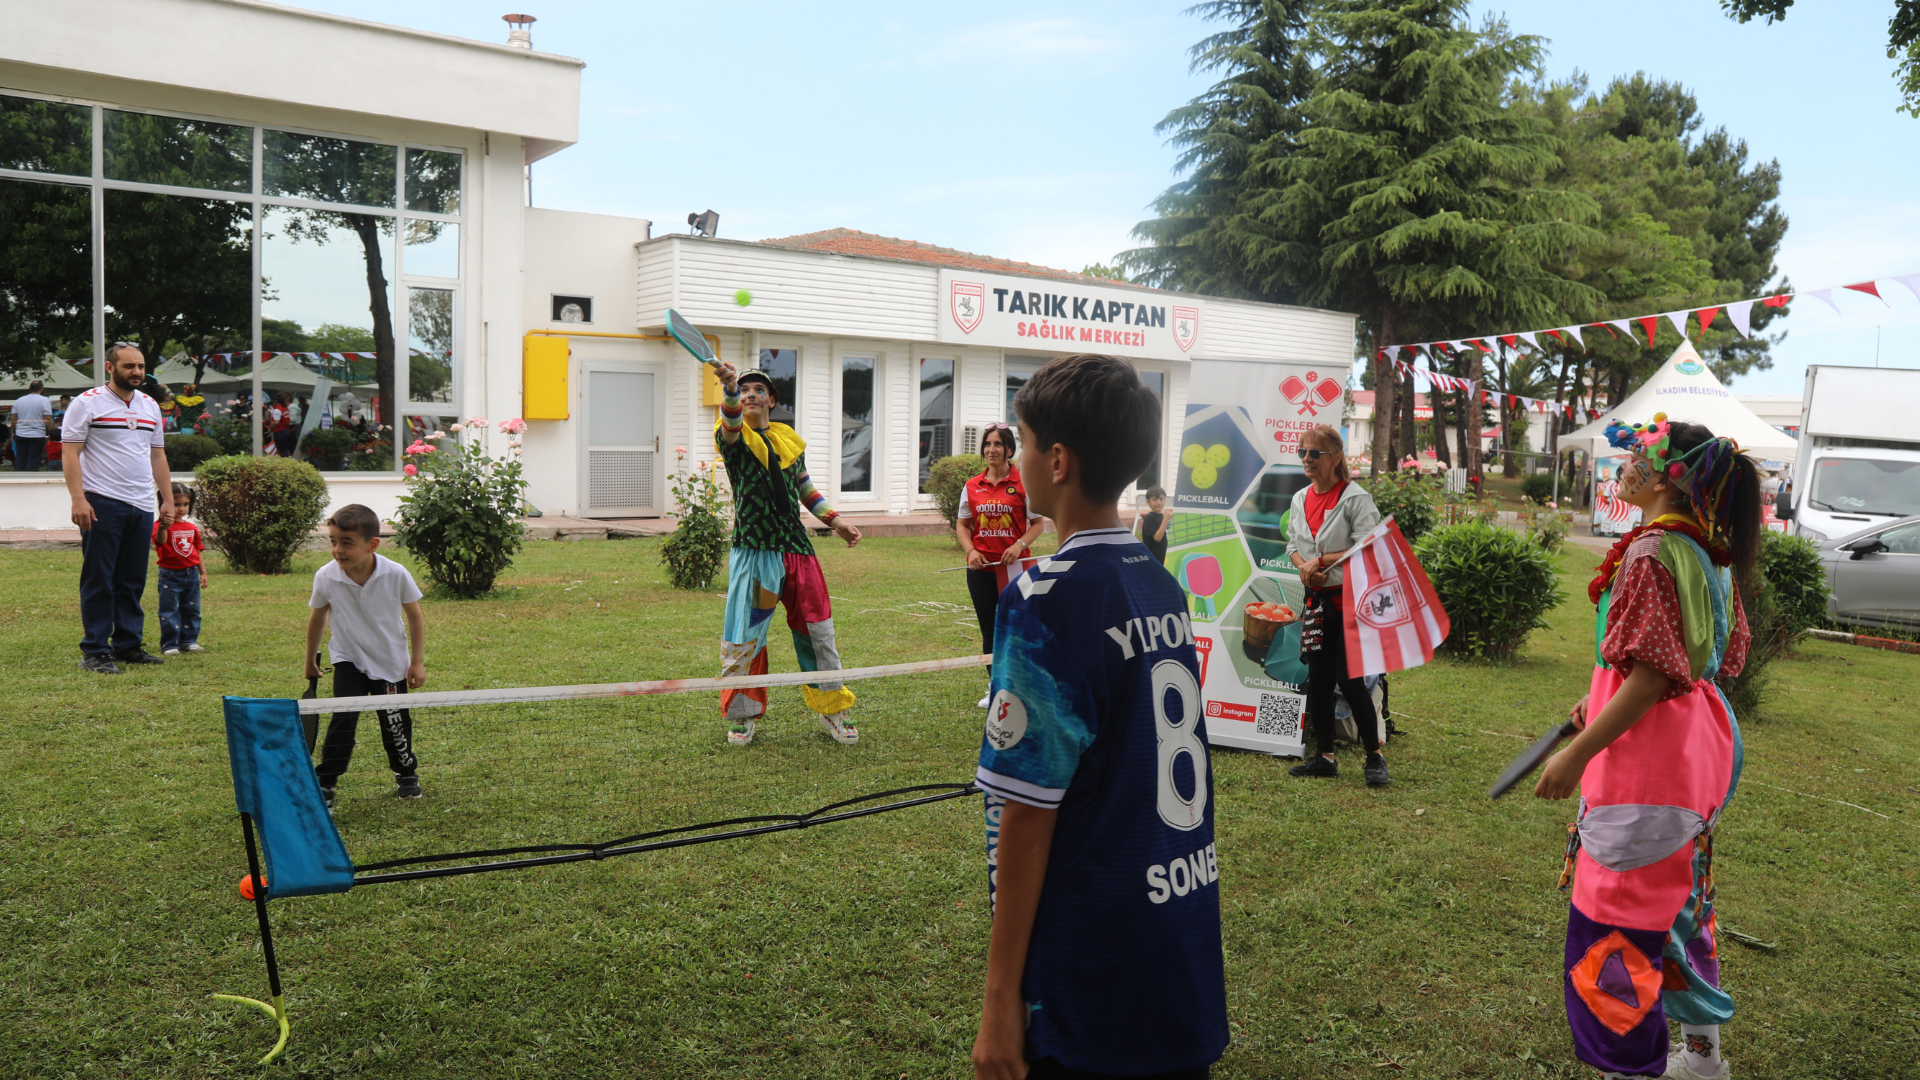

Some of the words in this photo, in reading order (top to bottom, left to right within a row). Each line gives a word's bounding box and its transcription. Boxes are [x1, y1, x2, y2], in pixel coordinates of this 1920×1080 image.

[992, 287, 1068, 319] TARIK
[1072, 296, 1166, 329] KAPTAN
[1017, 319, 1076, 341] SAĞLIK
[1079, 327, 1145, 347] MERKEZİ
[1655, 386, 1688, 396] İLKADIM
[1688, 386, 1730, 399] BELEDİYESİ
[1265, 418, 1333, 431] PICKLEBA
[1177, 494, 1230, 505] PICKLEBALL
[997, 504, 1013, 513] DAY
[1195, 640, 1210, 649] ALL
[1244, 676, 1301, 692] PICKLEBALL
[1150, 658, 1208, 832] 8
[1146, 842, 1219, 905] SONE
